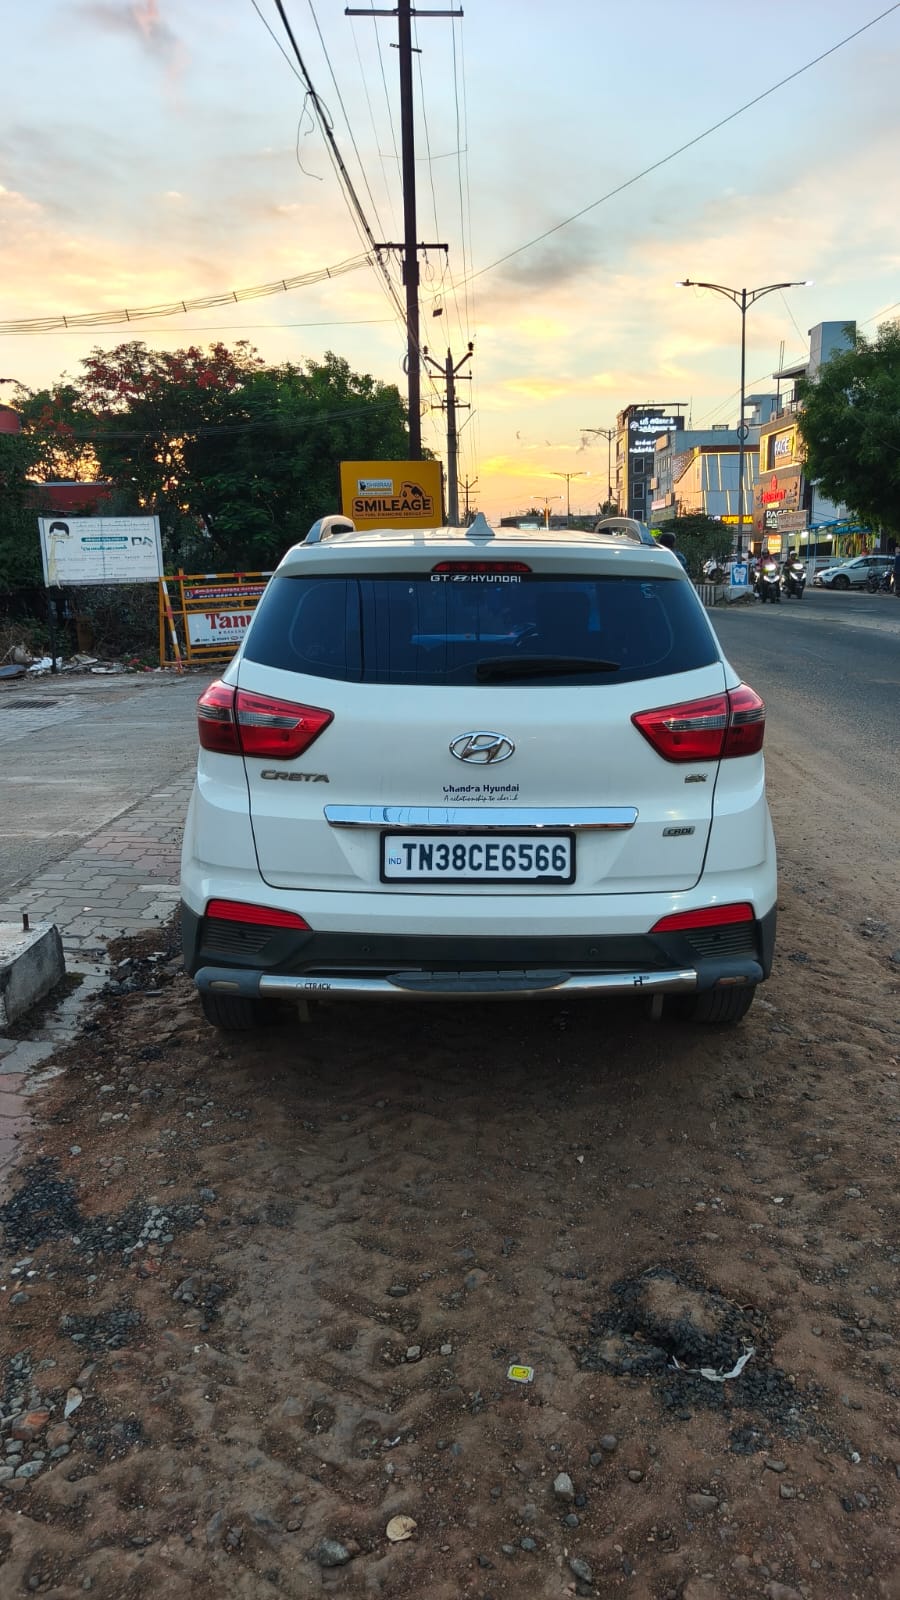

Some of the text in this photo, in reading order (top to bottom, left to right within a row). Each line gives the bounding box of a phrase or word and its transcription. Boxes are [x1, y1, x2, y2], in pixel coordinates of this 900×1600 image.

[355, 499, 431, 512] SMILEAGE
[430, 574, 521, 583] GT HYUNDAI
[260, 769, 330, 783] CRETA
[483, 783, 520, 794] Hyundai
[388, 843, 567, 872] IND TN38CE6566
